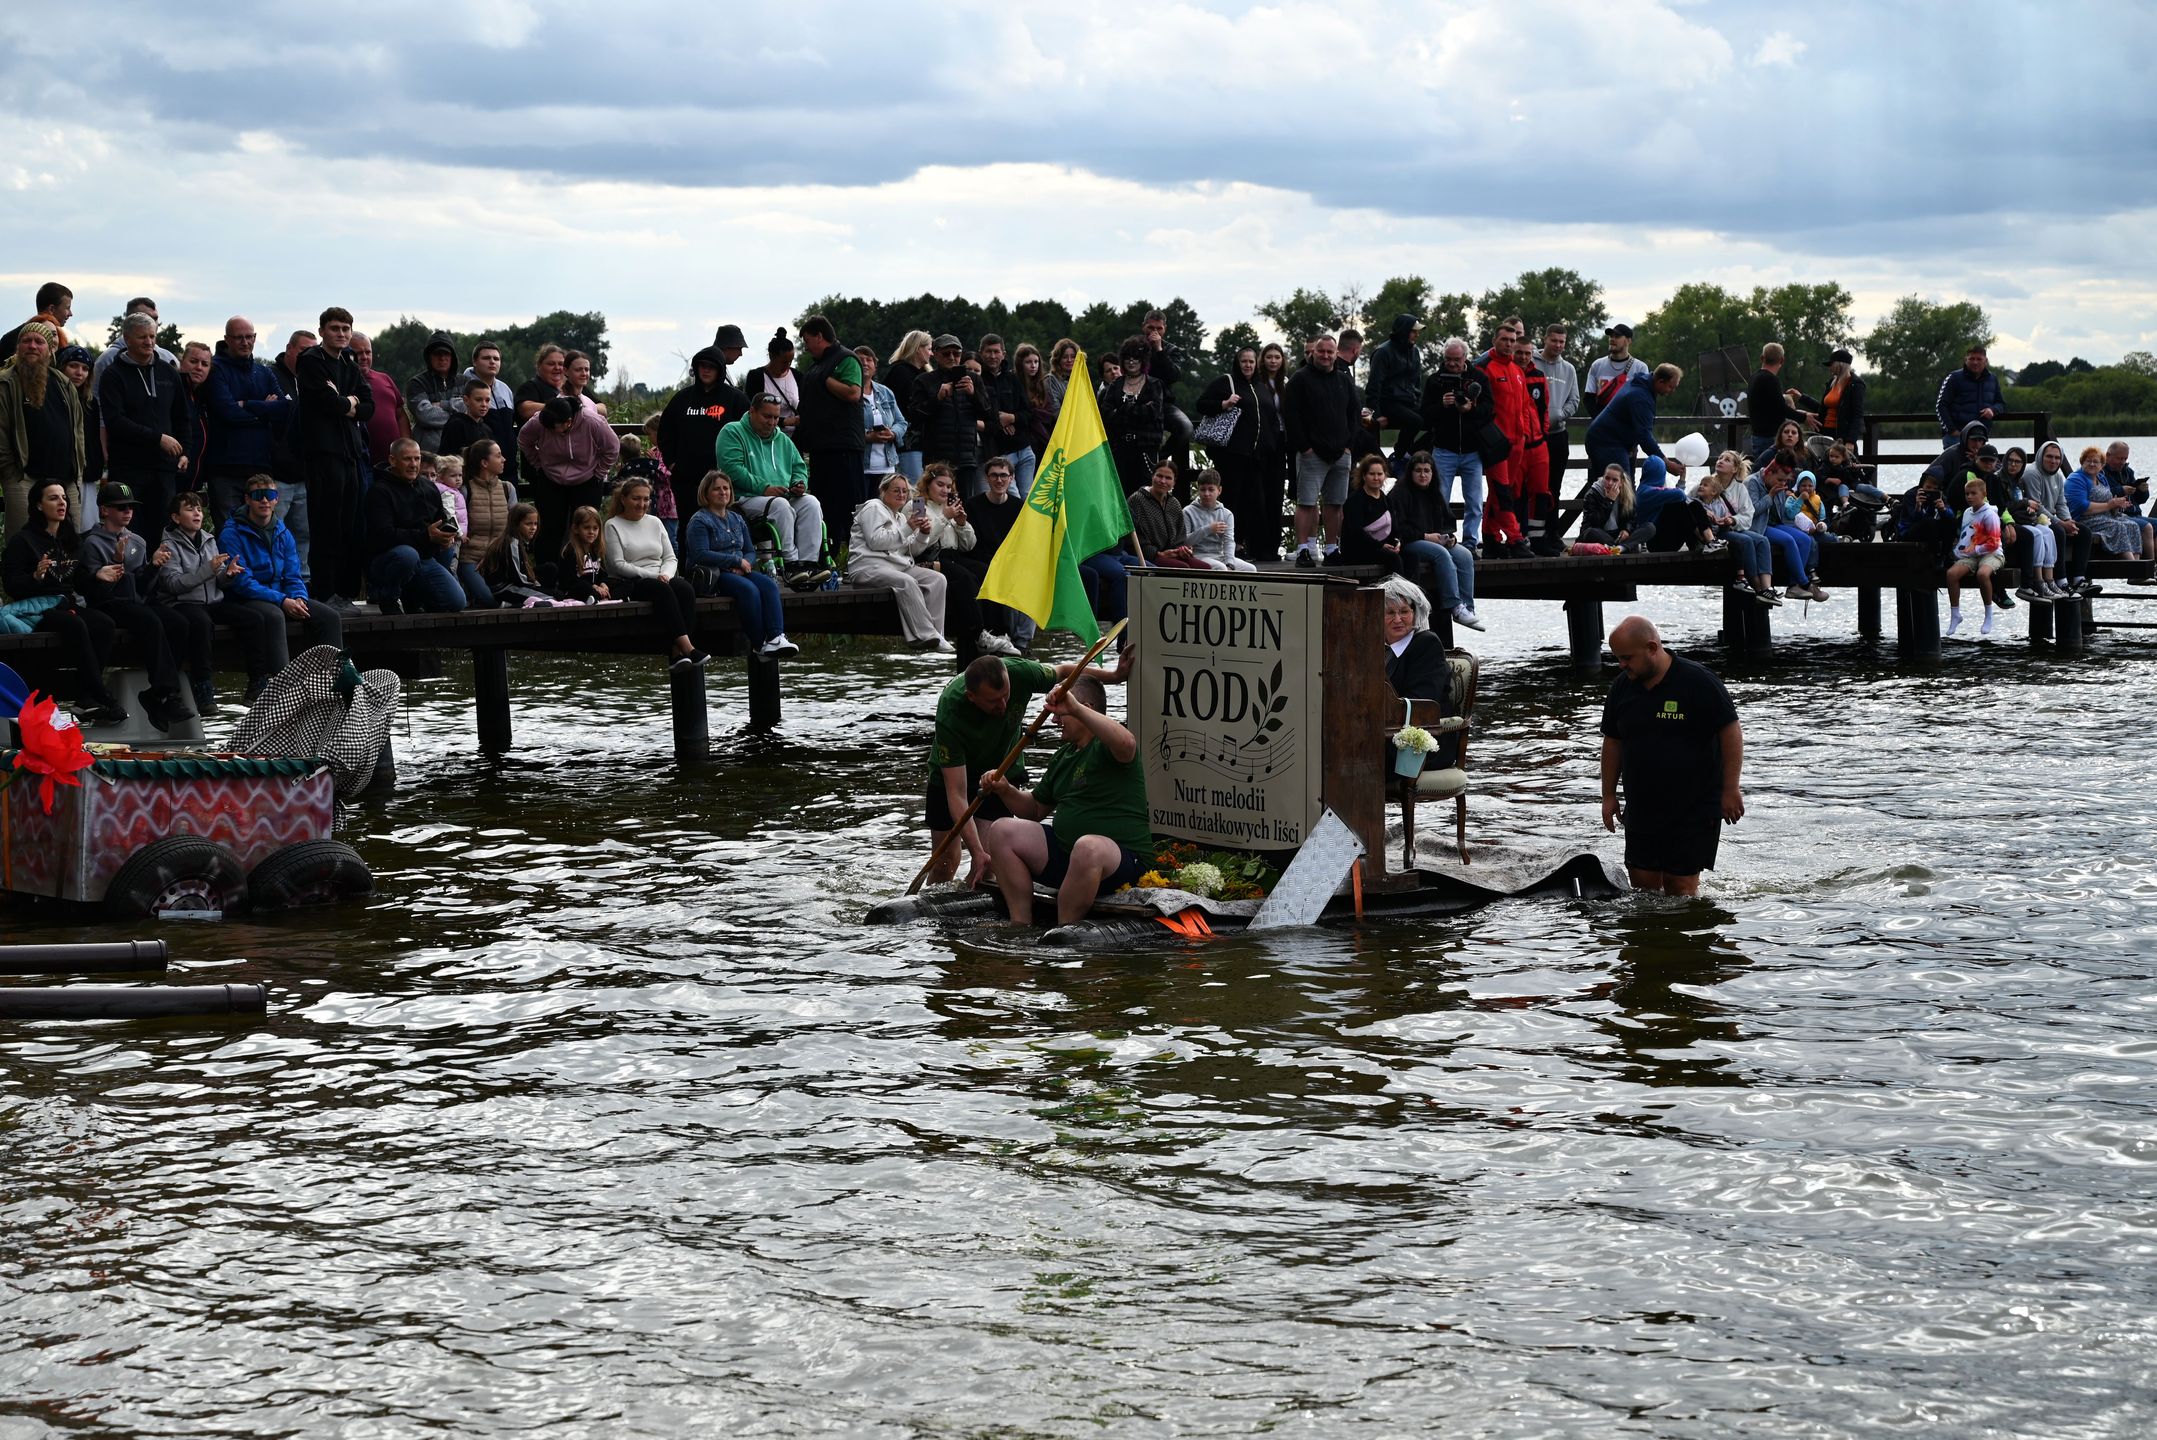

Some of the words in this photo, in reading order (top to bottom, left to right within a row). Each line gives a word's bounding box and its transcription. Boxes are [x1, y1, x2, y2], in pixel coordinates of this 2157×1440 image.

[1182, 582, 1258, 602] FRYDERYK
[1159, 602, 1284, 651] CHOPIN
[1212, 650, 1216, 666] i
[1161, 666, 1249, 723] ROD
[1655, 711, 1685, 720] ARTUR
[1174, 778, 1207, 804] Nurt
[1211, 785, 1266, 812] melodii
[1153, 808, 1187, 829] szum
[1188, 809, 1270, 842] działkowych
[1273, 819, 1300, 844] liści
